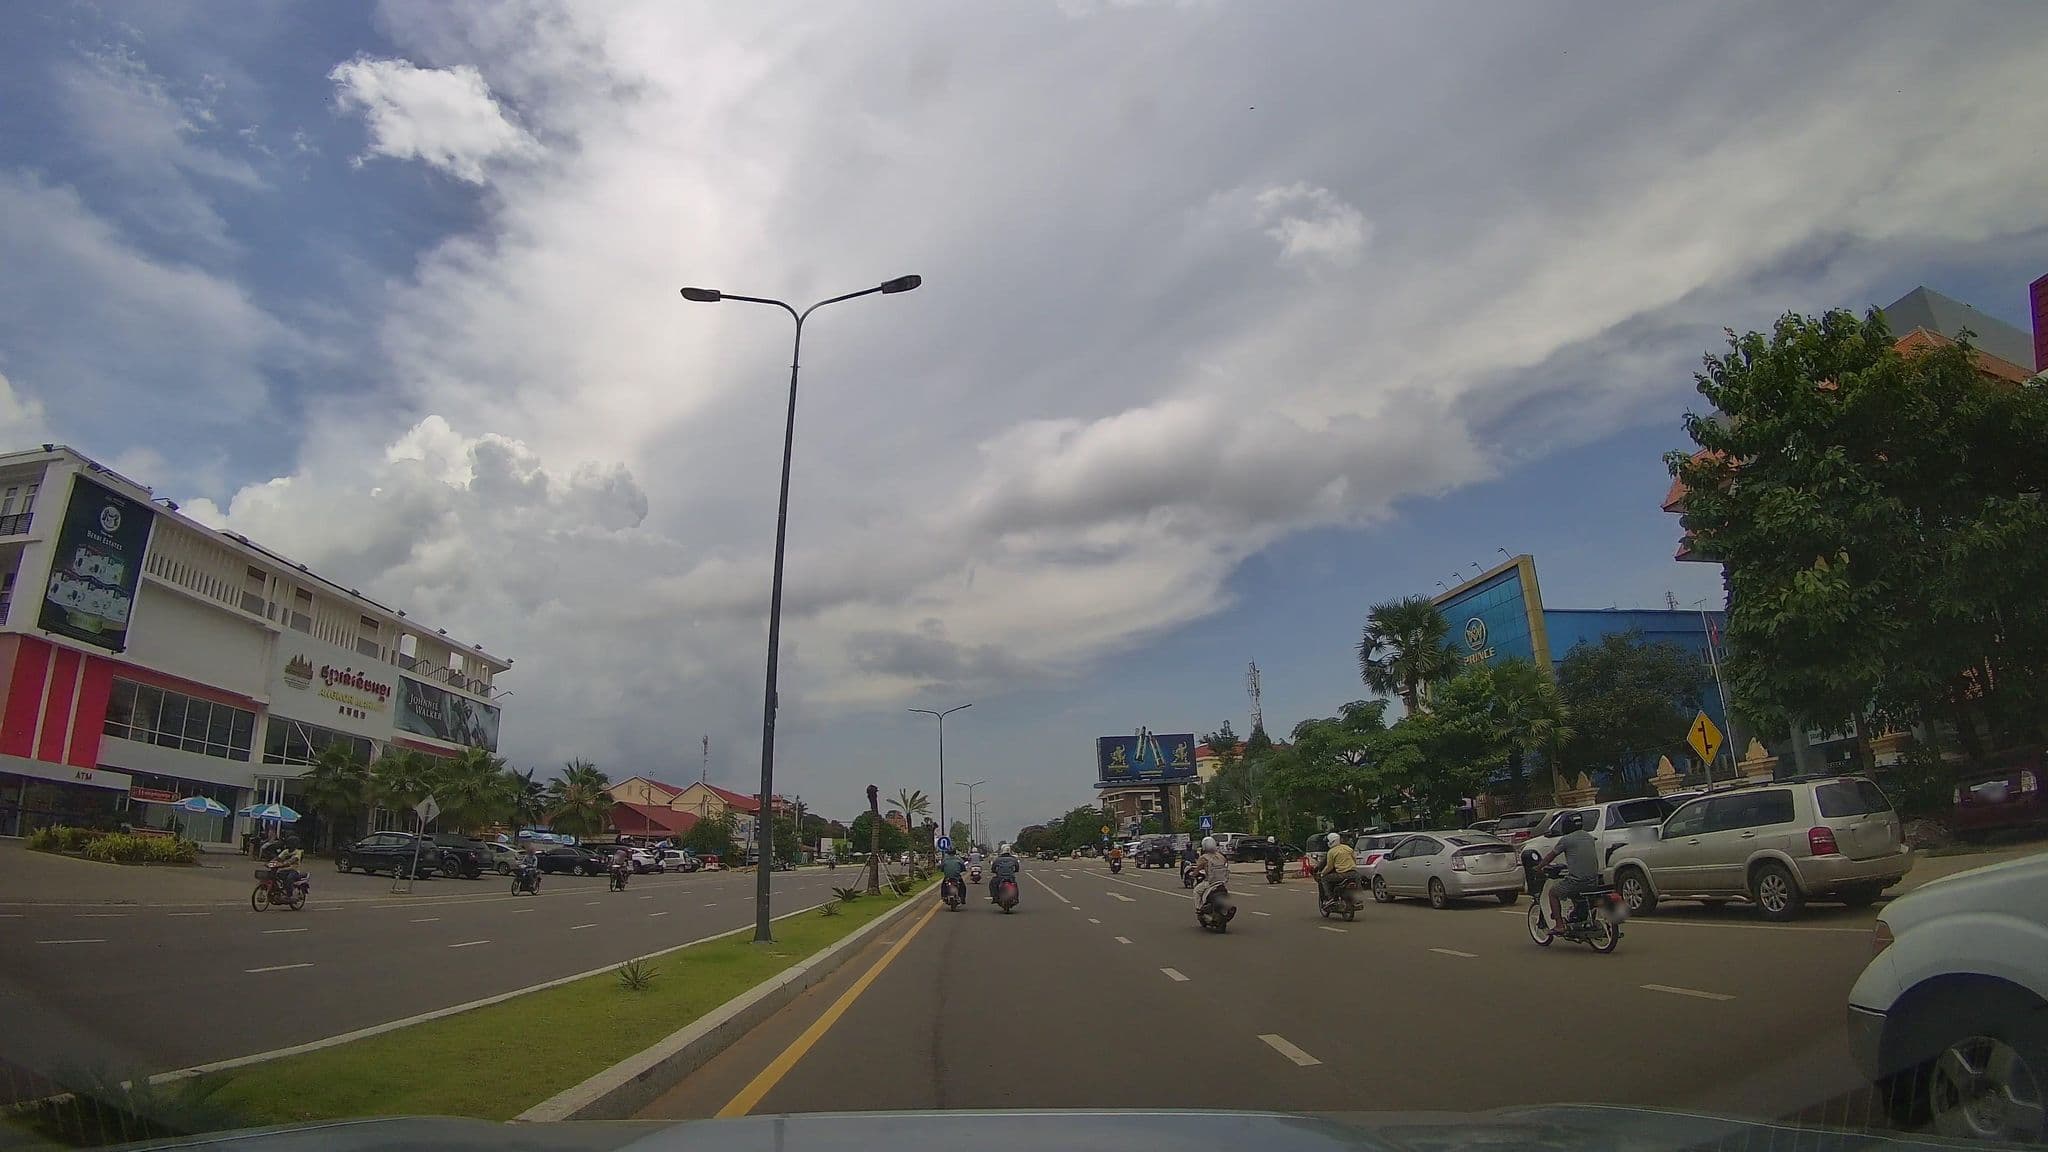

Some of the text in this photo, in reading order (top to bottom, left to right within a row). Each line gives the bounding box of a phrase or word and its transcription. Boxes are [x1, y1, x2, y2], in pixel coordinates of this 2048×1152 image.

[1463, 646, 1497, 665] PRINCE
[408, 693, 440, 712] JOHNNIE
[415, 705, 442, 721] WALKER
[75, 770, 92, 781] ATM
